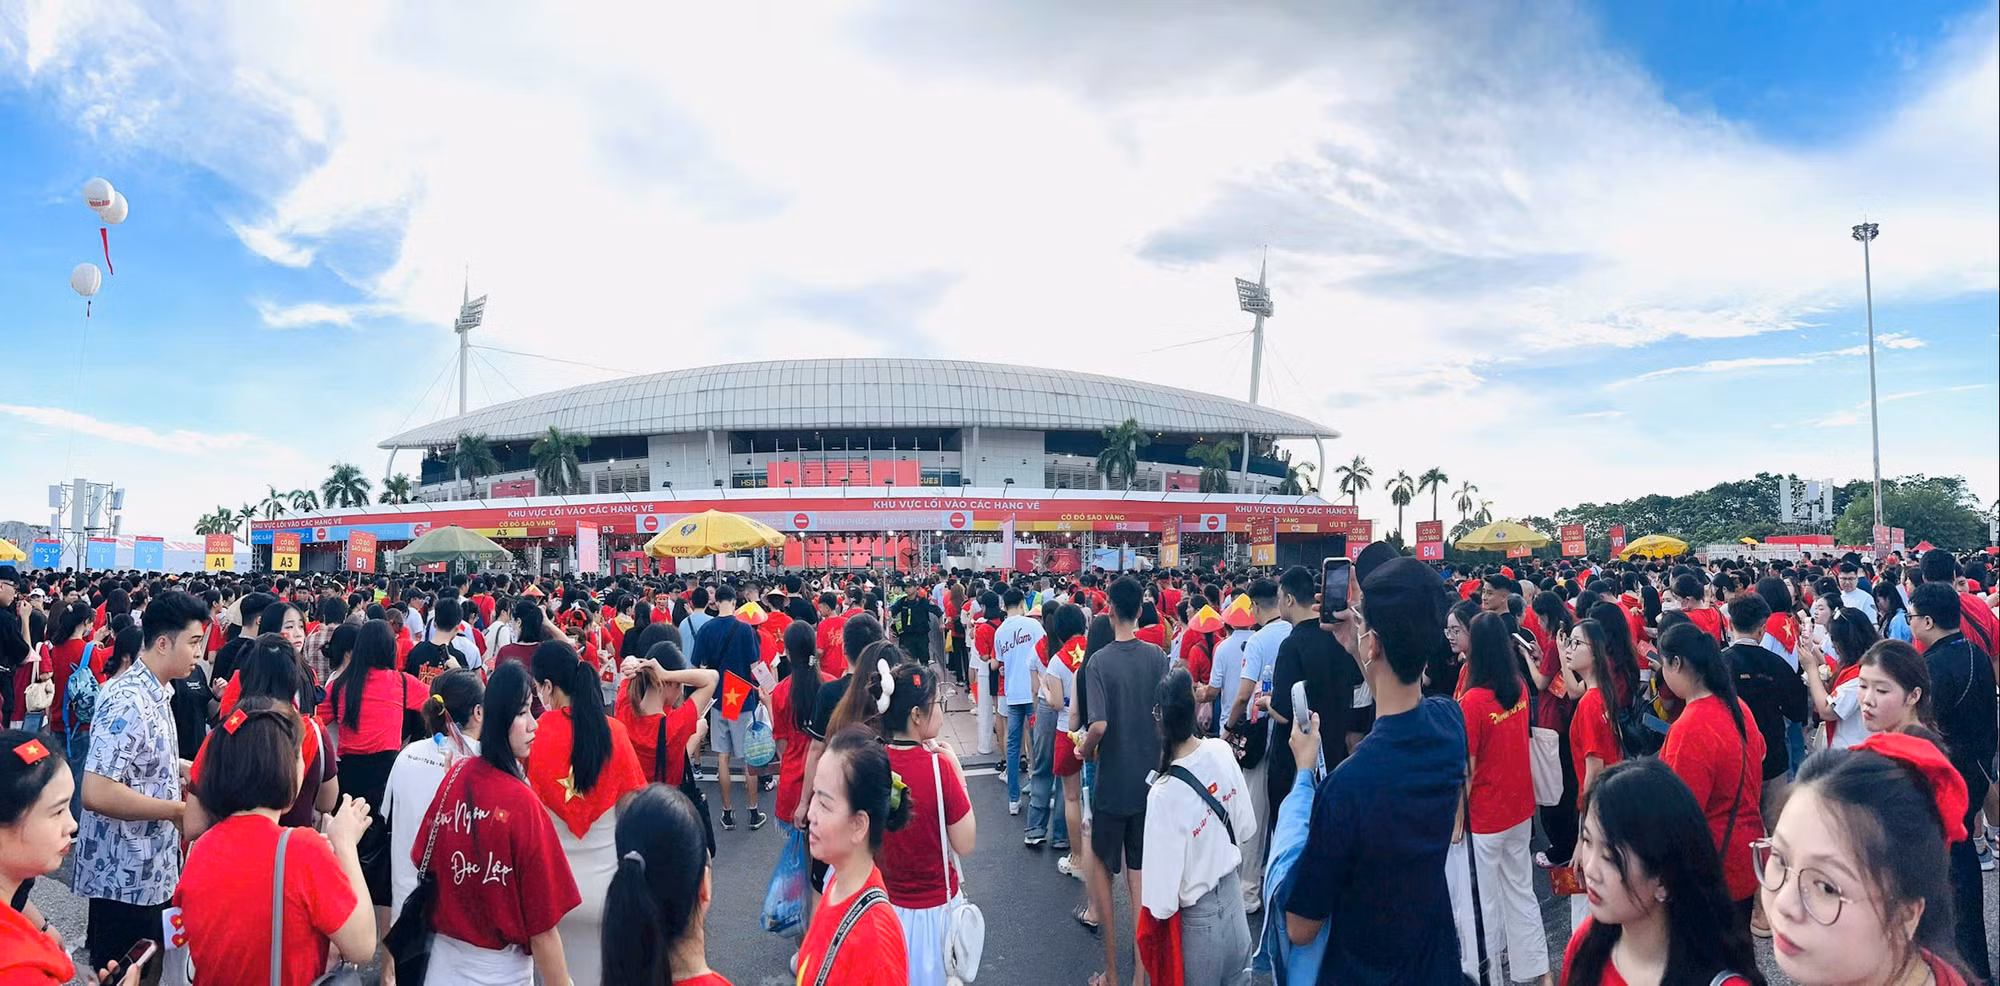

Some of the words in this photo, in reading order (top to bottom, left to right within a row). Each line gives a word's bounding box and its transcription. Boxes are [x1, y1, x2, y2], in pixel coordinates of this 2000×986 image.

[899, 500, 922, 510] VỰC
[924, 498, 941, 508] LỐI
[944, 499, 966, 508] VÀO
[970, 500, 990, 508] CÁC
[994, 502, 1024, 511] HẠNG
[1026, 500, 1040, 509] VÉ
[528, 509, 546, 518] VỰC
[550, 507, 564, 516] LỐI
[566, 506, 586, 515] VÀO
[588, 505, 608, 514] CÁC
[610, 505, 638, 515] HẠNG
[641, 503, 654, 512] VÉ
[1254, 506, 1270, 514] VỰC
[1289, 506, 1305, 514] VÀO
[1326, 508, 1346, 516] HẠNG
[1612, 537, 1623, 547] VIP
[1424, 546, 1435, 556] B4
[1568, 544, 1579, 553] C2
[101, 555, 104, 563] 1
[146, 555, 152, 564] 2
[214, 558, 225, 567] A1
[280, 557, 293, 567] A3
[356, 557, 366, 569] B1
[1010, 628, 1032, 648] Nam
[455, 800, 490, 834] Ngôn
[451, 850, 480, 885] Độc
[482, 851, 512, 886] Lập
